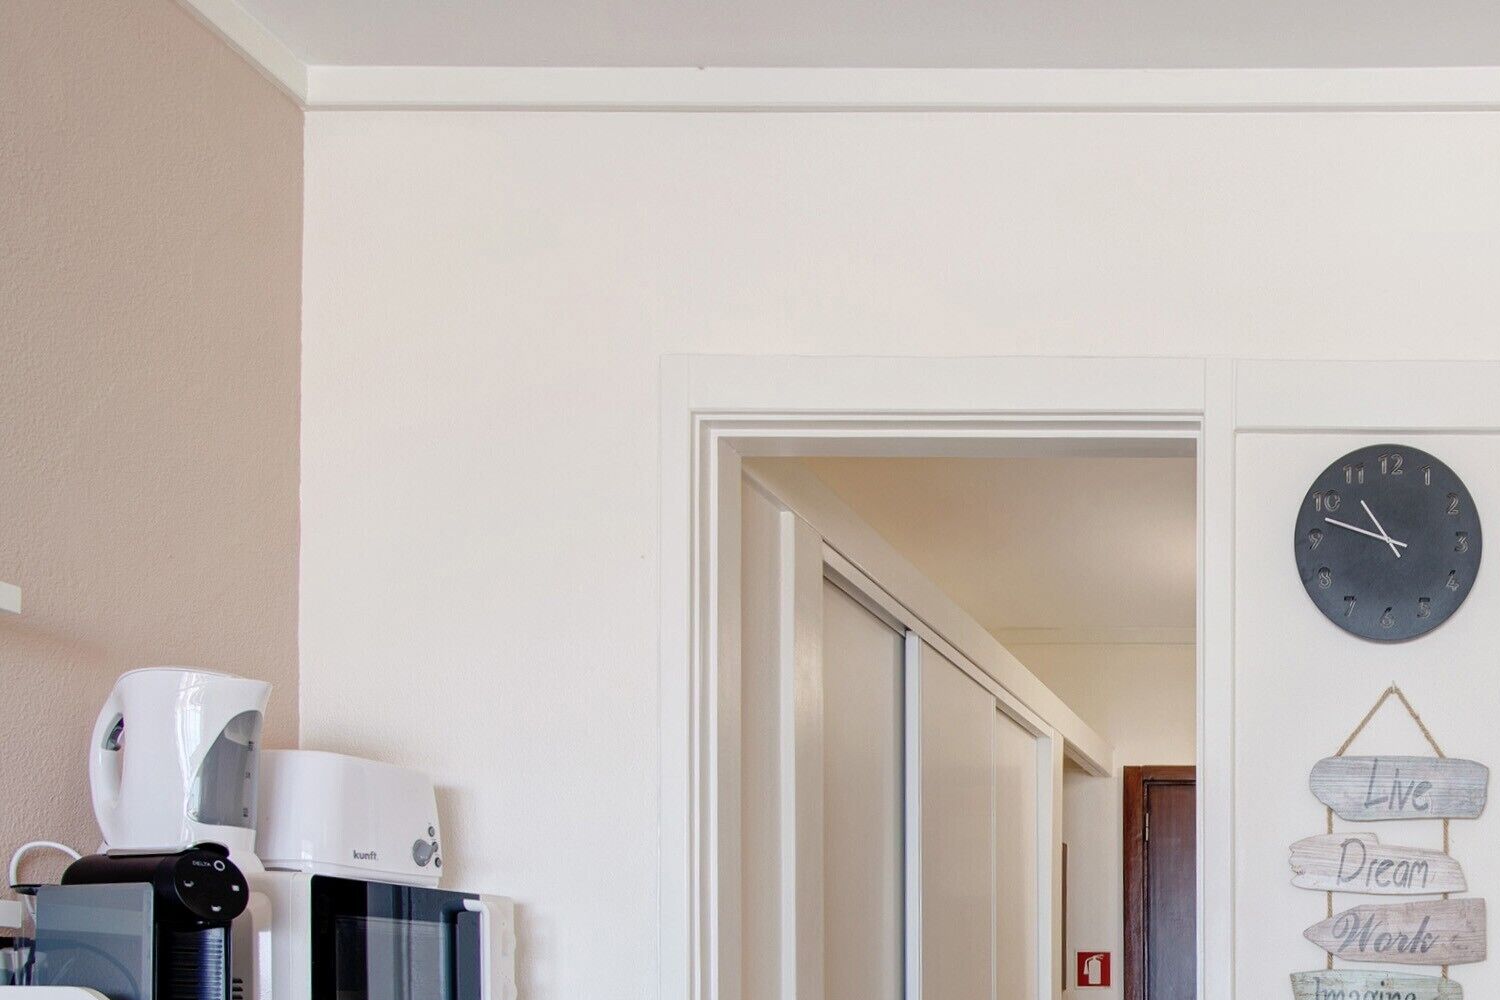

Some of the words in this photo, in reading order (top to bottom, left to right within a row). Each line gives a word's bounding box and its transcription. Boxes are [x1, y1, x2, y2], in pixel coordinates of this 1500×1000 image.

[1342, 463, 1367, 485] 11
[1377, 453, 1405, 477] 12
[1420, 464, 1432, 486] 1
[1311, 489, 1342, 512] 10
[1446, 492, 1460, 515] 2
[1308, 528, 1325, 551] 9
[1454, 531, 1470, 554] 3
[1317, 566, 1333, 590] 8
[1445, 569, 1460, 592] 4
[1343, 595, 1359, 618] 7
[1379, 606, 1395, 630] 6
[1416, 597, 1431, 619] 5
[1362, 757, 1434, 813] Live
[191, 860, 212, 868] DELTA
[352, 850, 378, 861] kunft
[1335, 837, 1430, 890] Dream
[1331, 911, 1440, 954] Work
